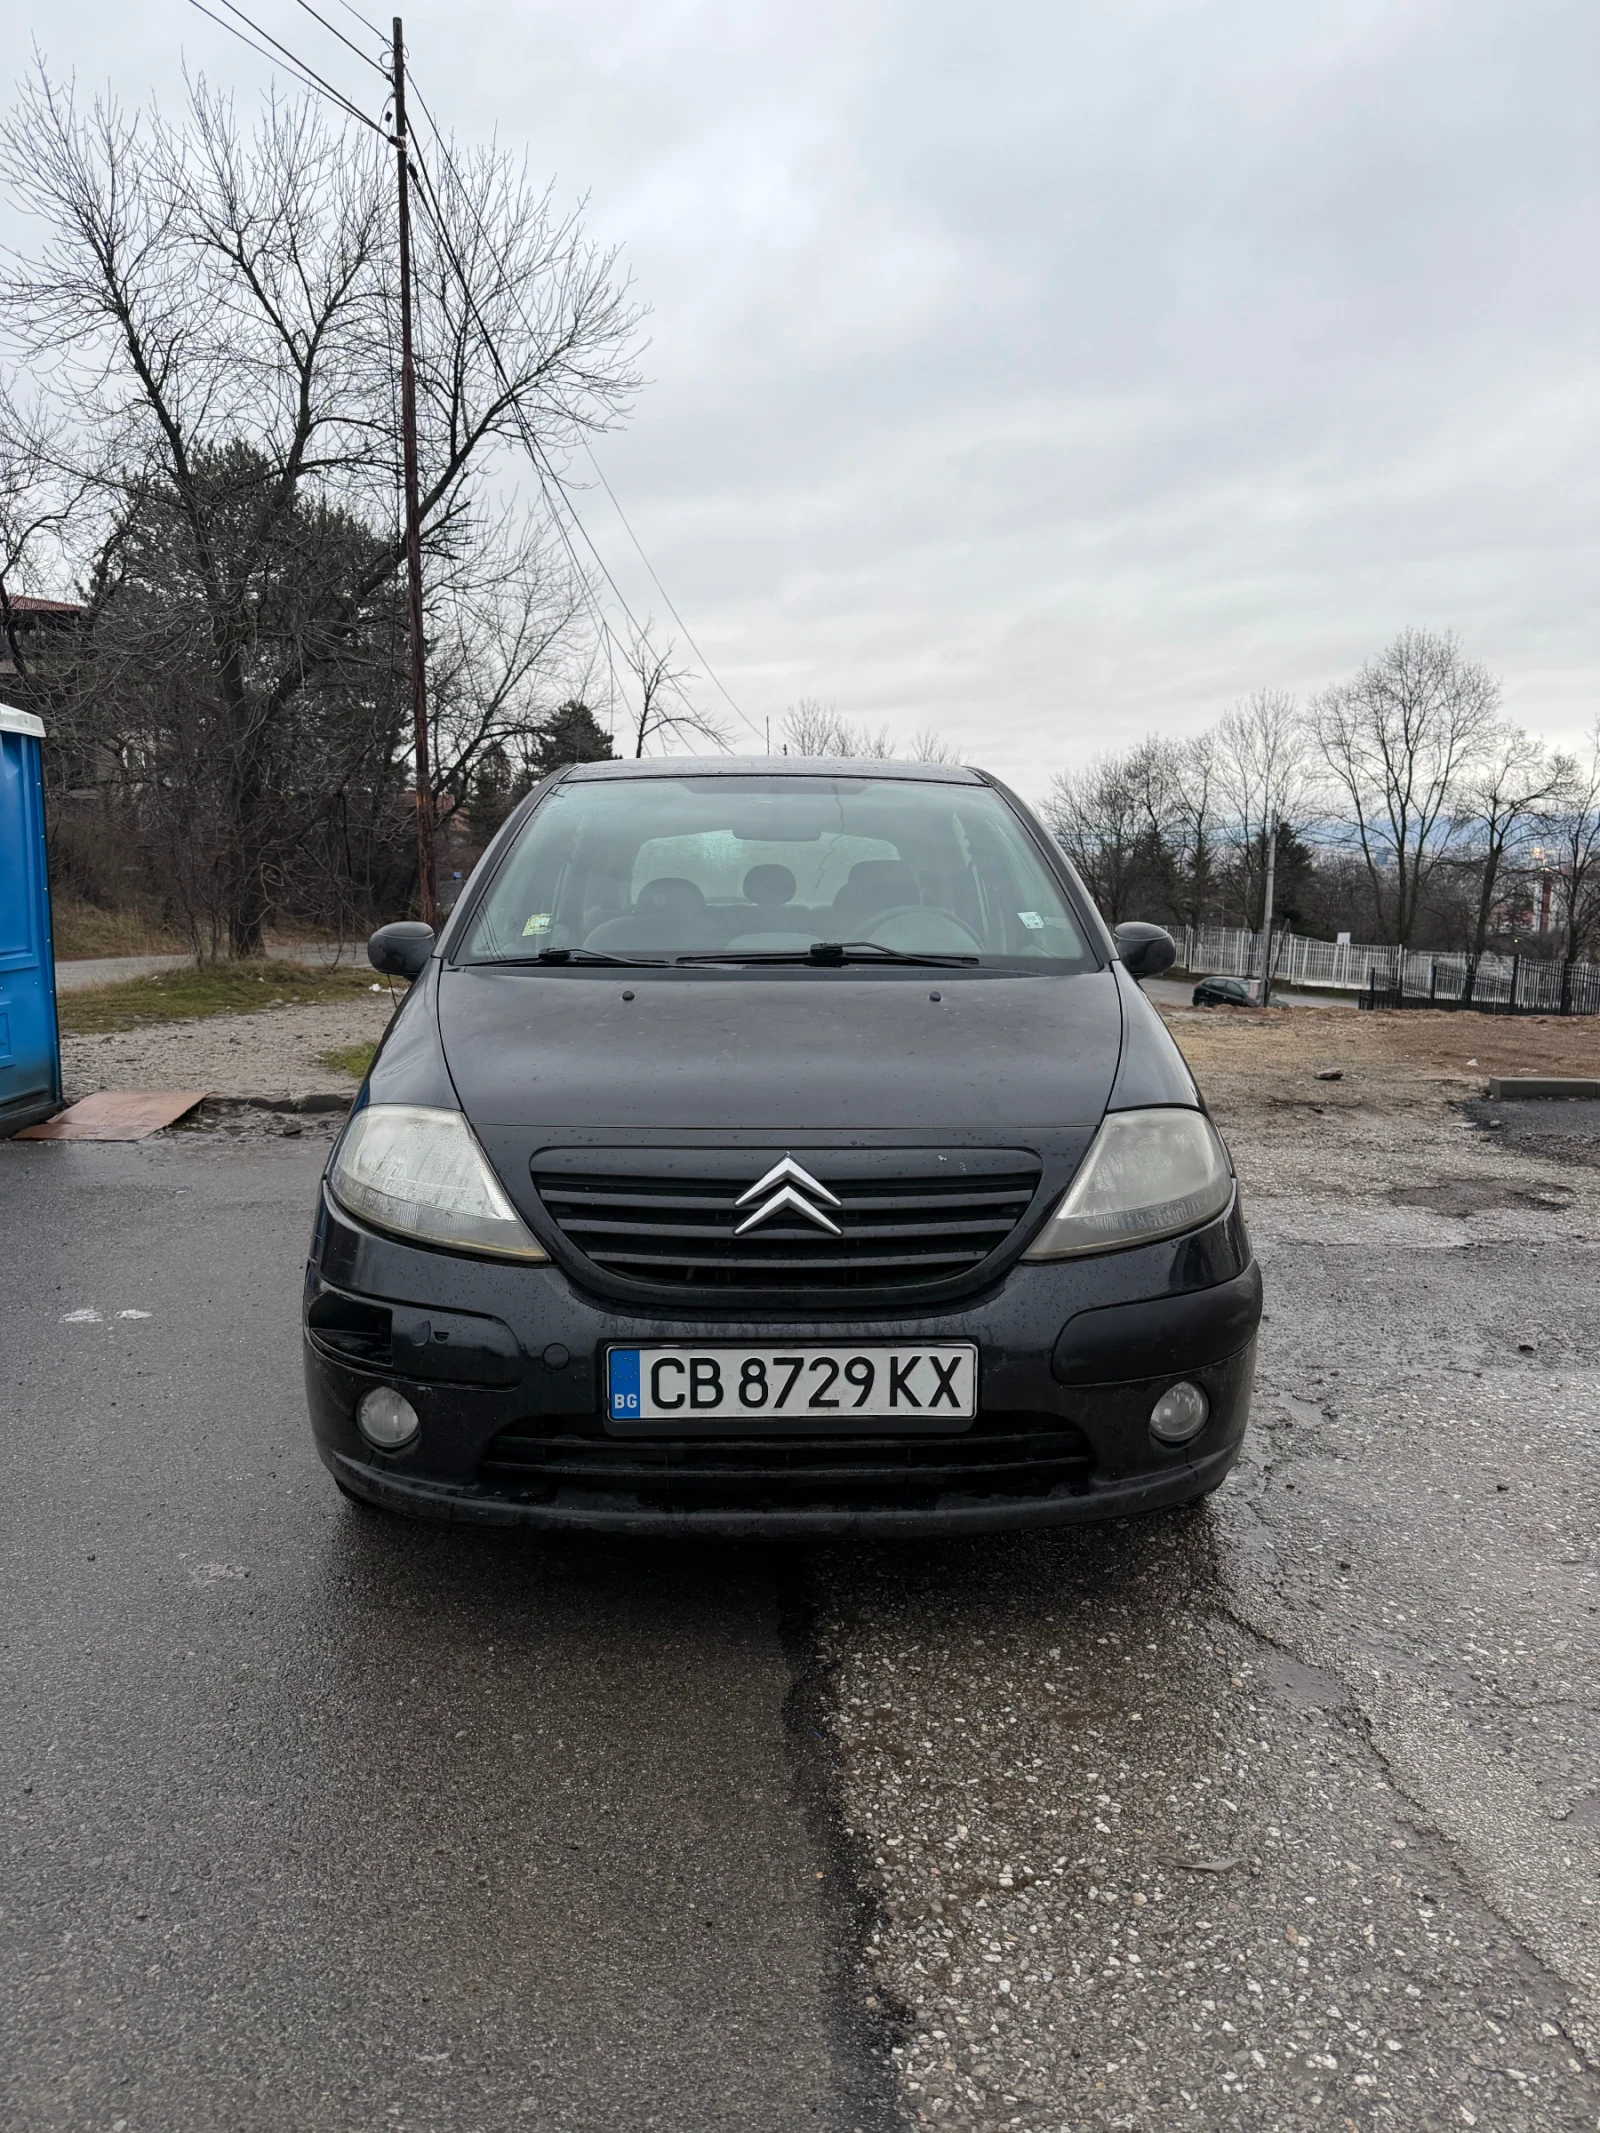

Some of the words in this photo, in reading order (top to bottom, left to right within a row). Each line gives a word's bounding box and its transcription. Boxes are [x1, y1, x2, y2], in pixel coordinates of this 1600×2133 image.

[650, 1356, 724, 1409] CB
[738, 1356, 875, 1409] 8729
[889, 1355, 962, 1408] KX
[614, 1393, 638, 1409] BG
